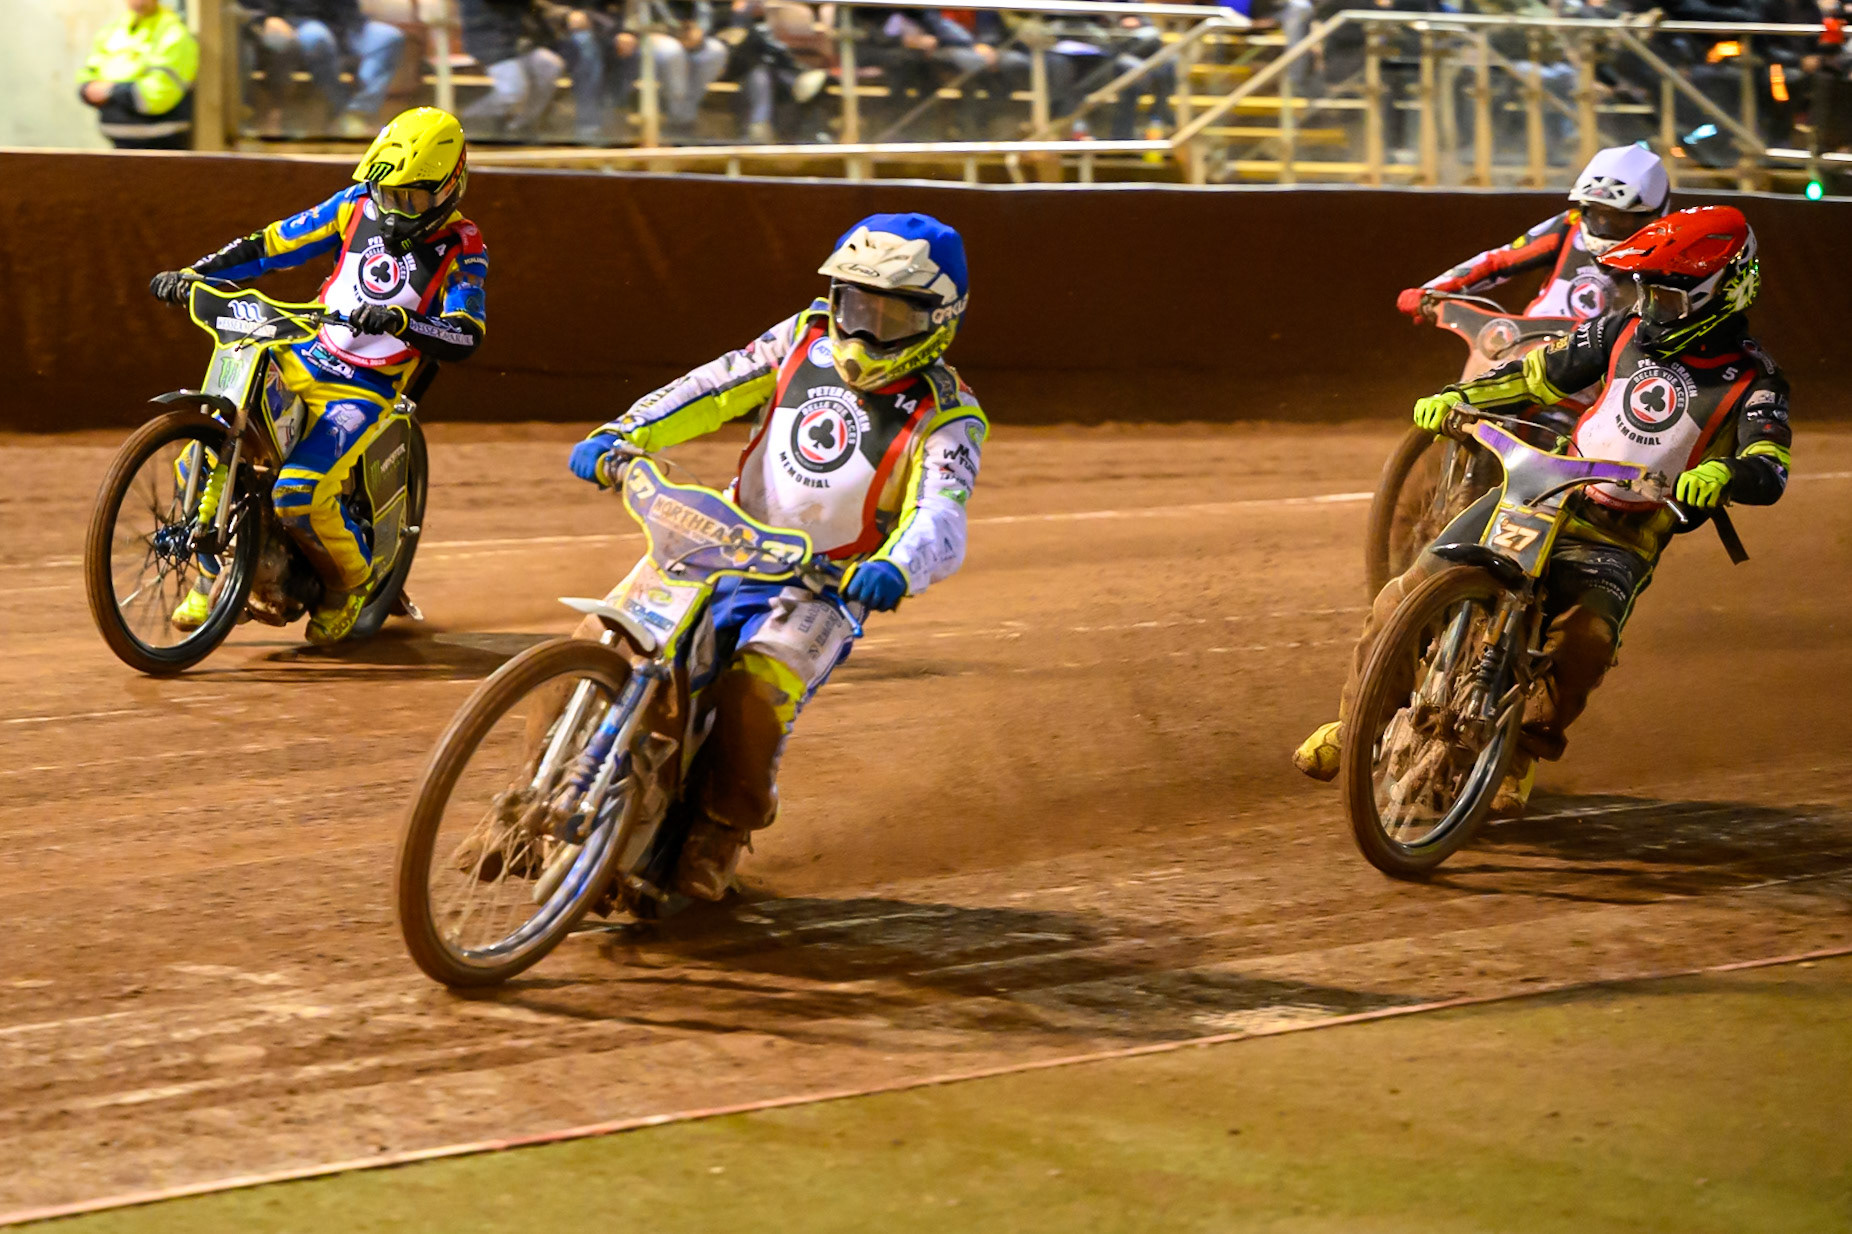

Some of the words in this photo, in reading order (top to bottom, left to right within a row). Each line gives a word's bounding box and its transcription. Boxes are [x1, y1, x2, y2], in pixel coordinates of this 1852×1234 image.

[434, 243, 447, 256] 4
[1633, 370, 1659, 384] BELLE
[1662, 371, 1678, 385] VUE
[1675, 386, 1685, 408] ACES
[1671, 362, 1698, 398] CRAVEN
[1722, 366, 1739, 381] 5
[894, 393, 917, 415] 14
[1615, 413, 1661, 446] MEMORIAL
[779, 451, 831, 488] MEMORIAL
[1492, 518, 1542, 552] 27
